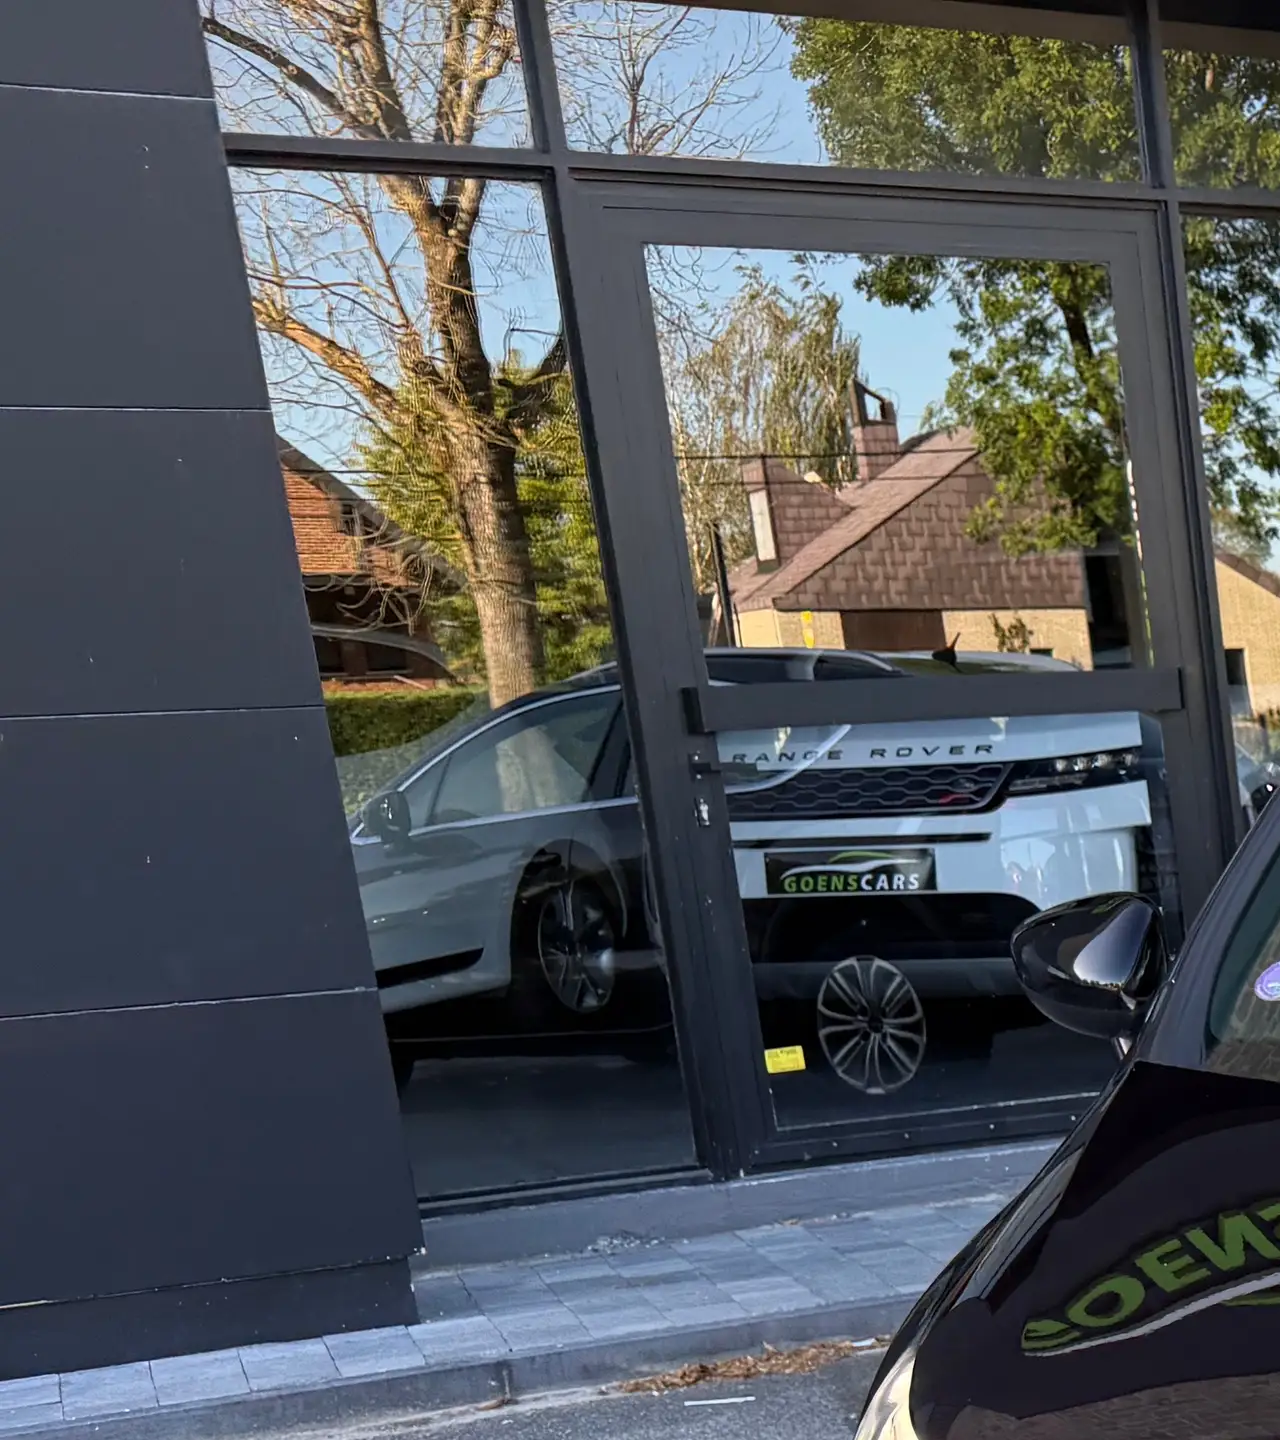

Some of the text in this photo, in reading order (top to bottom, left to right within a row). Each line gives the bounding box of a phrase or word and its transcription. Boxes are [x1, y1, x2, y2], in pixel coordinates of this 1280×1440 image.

[732, 744, 993, 763] RANGE ROVER
[783, 872, 920, 893] GOENSCARS
